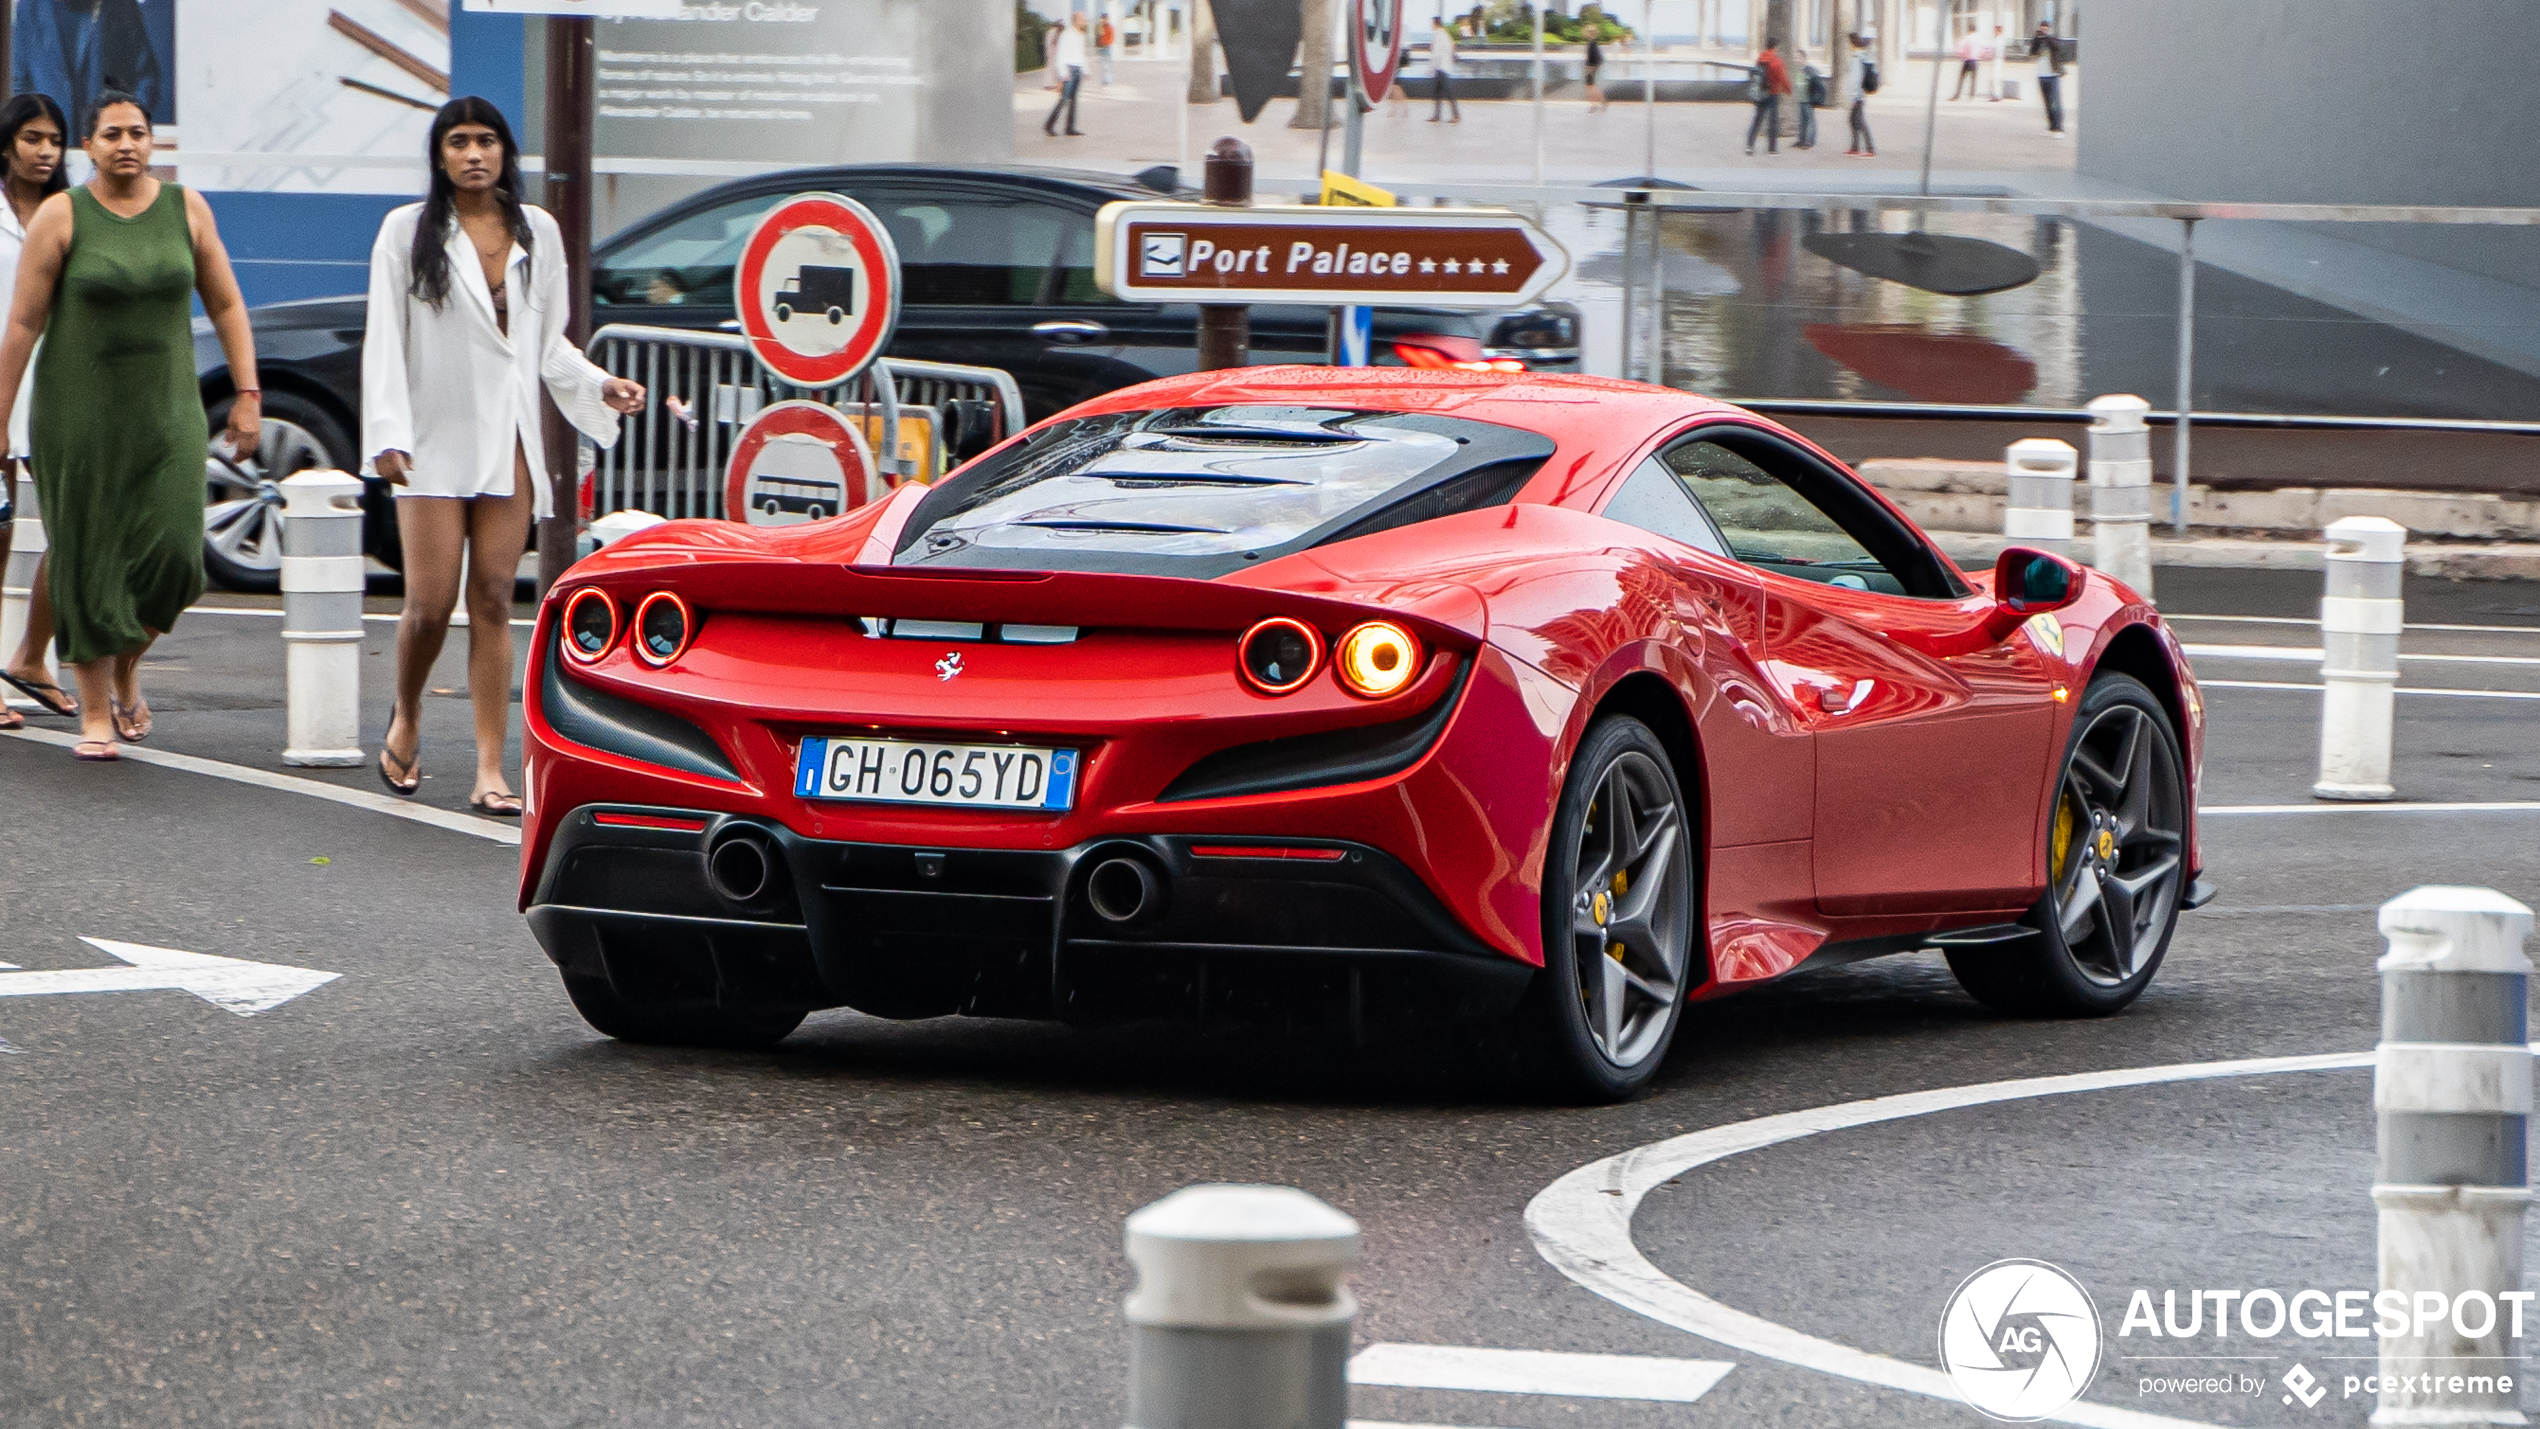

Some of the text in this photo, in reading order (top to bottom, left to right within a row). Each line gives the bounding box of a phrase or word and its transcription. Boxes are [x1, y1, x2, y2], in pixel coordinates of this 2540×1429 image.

[744, 2, 819, 22] Calder
[1188, 240, 1412, 275] Port Palace
[828, 744, 1043, 802] GH 065YD
